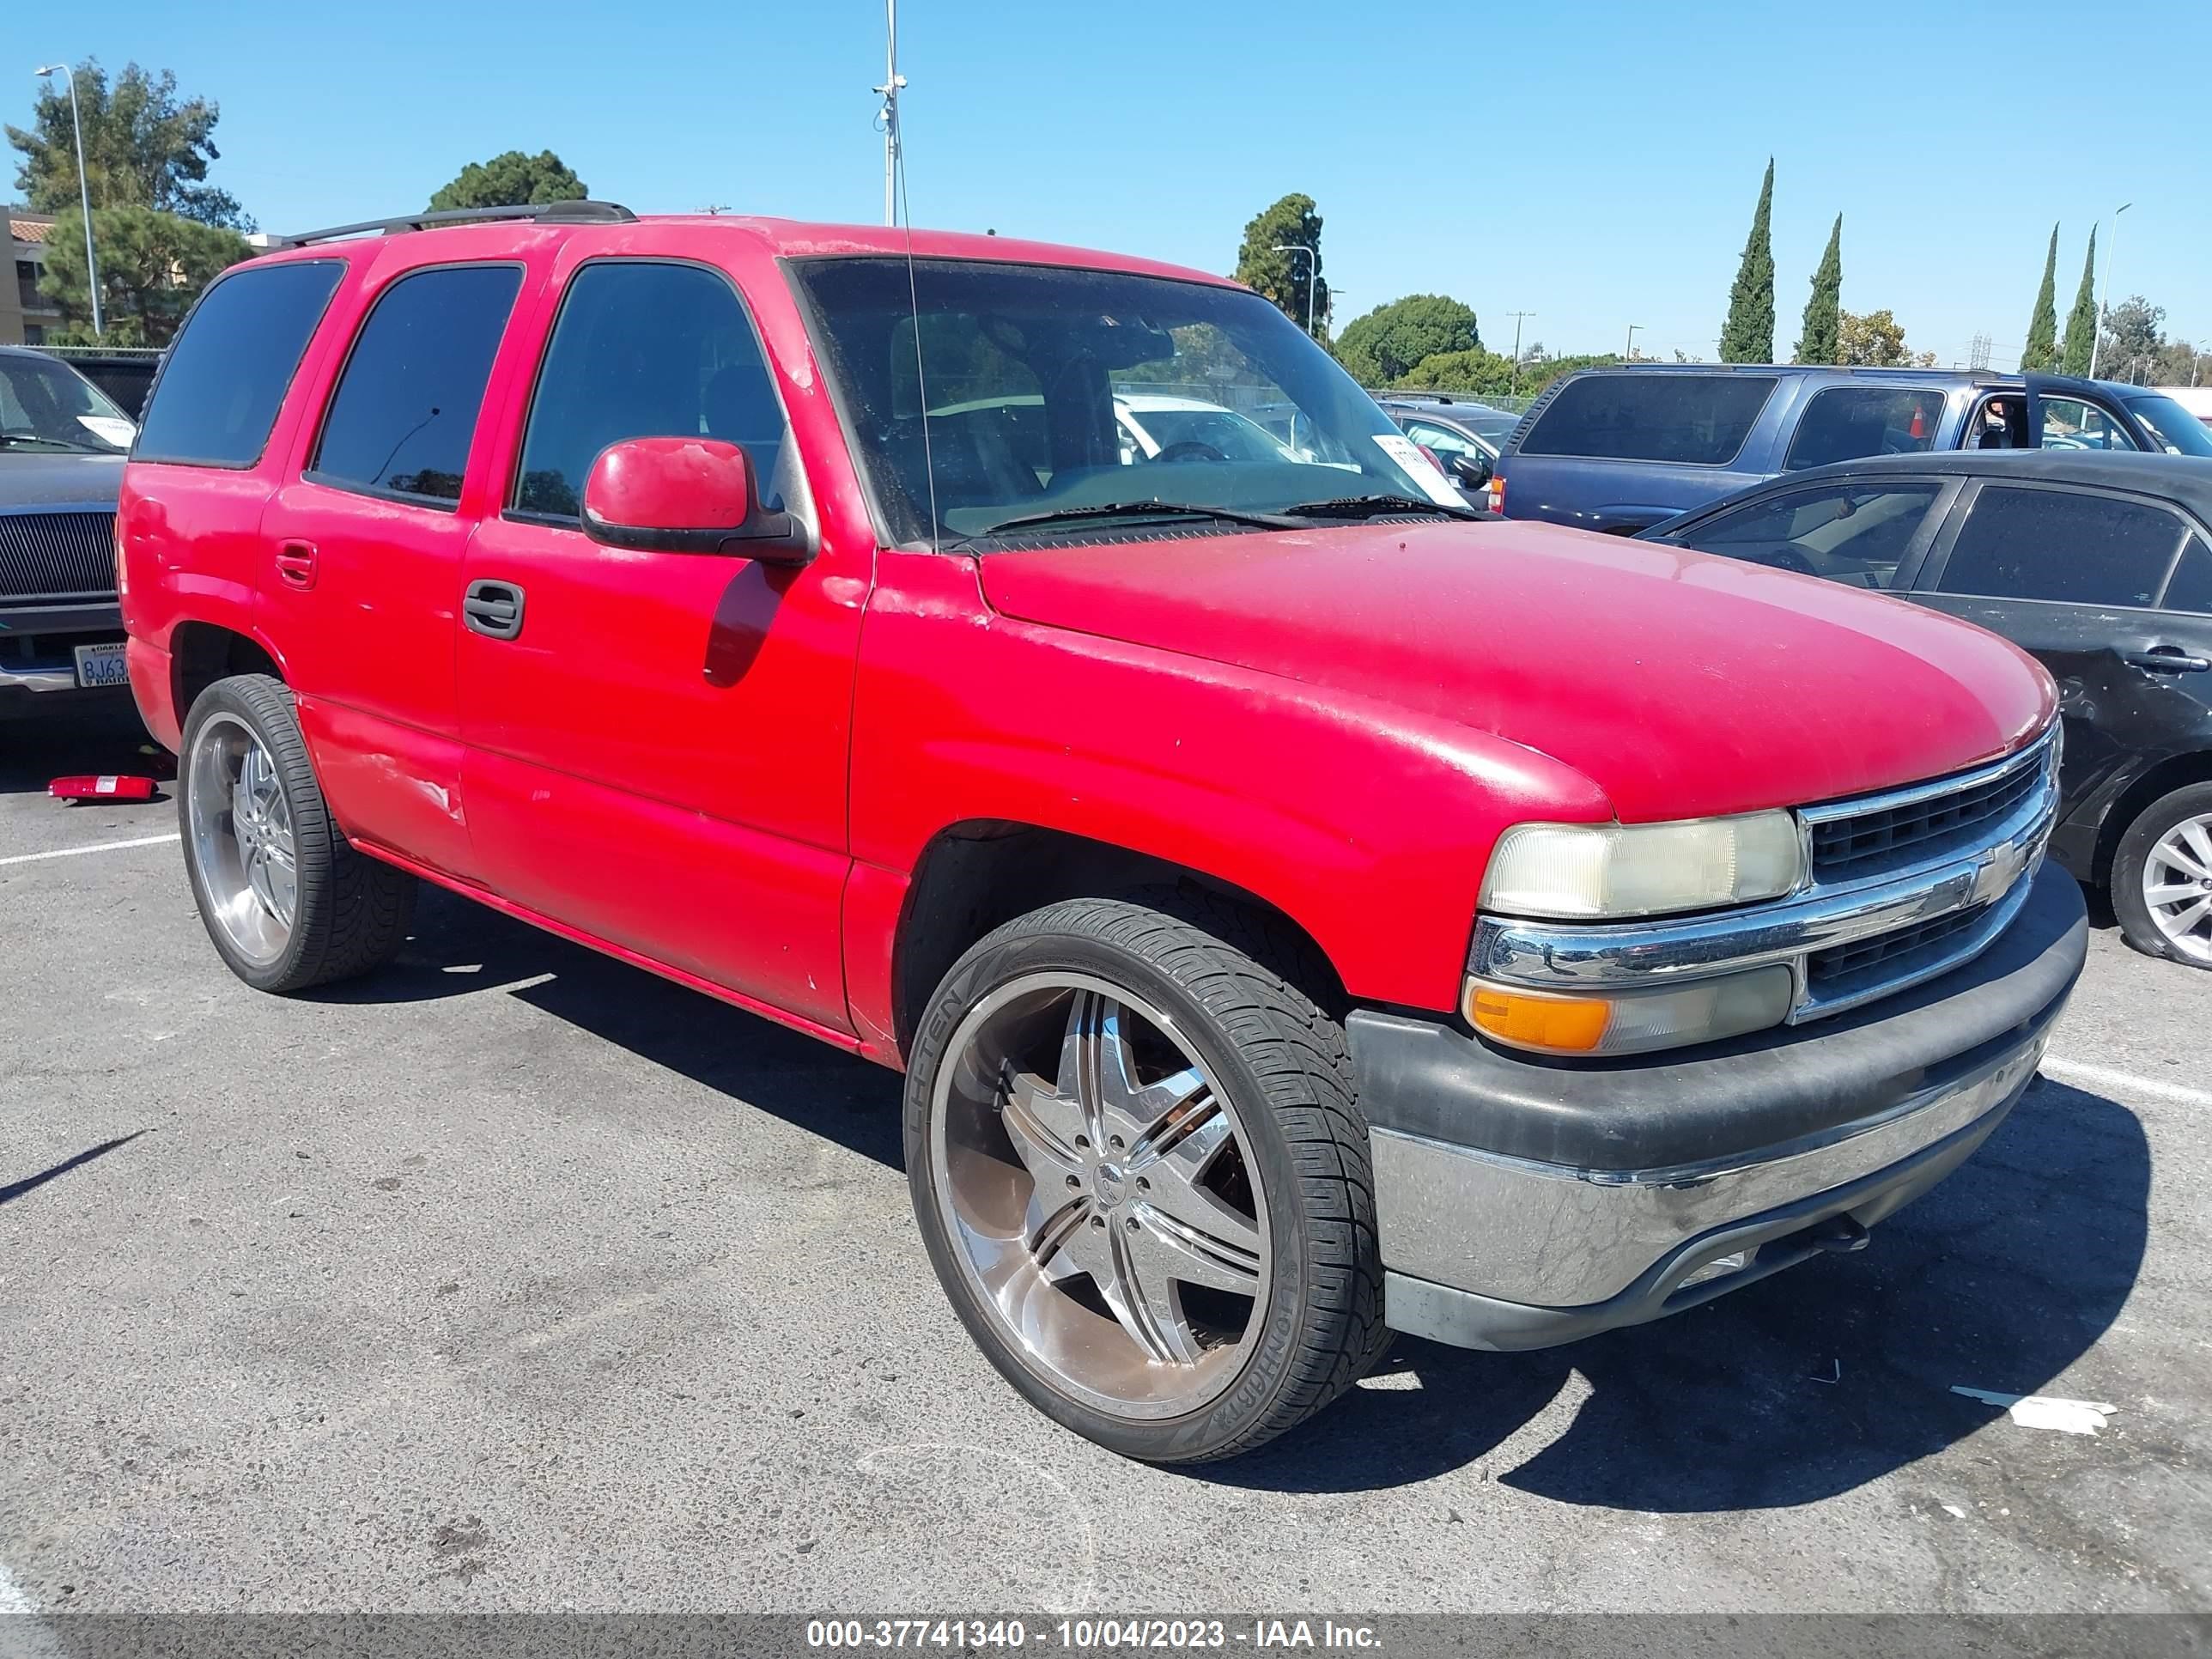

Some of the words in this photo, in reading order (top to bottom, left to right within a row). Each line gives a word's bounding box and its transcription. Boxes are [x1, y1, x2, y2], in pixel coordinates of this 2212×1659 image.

[84, 659, 128, 679] 8J63
[908, 988, 963, 1134] LH-TEN
[1227, 1283, 1299, 1425] LIONHART
